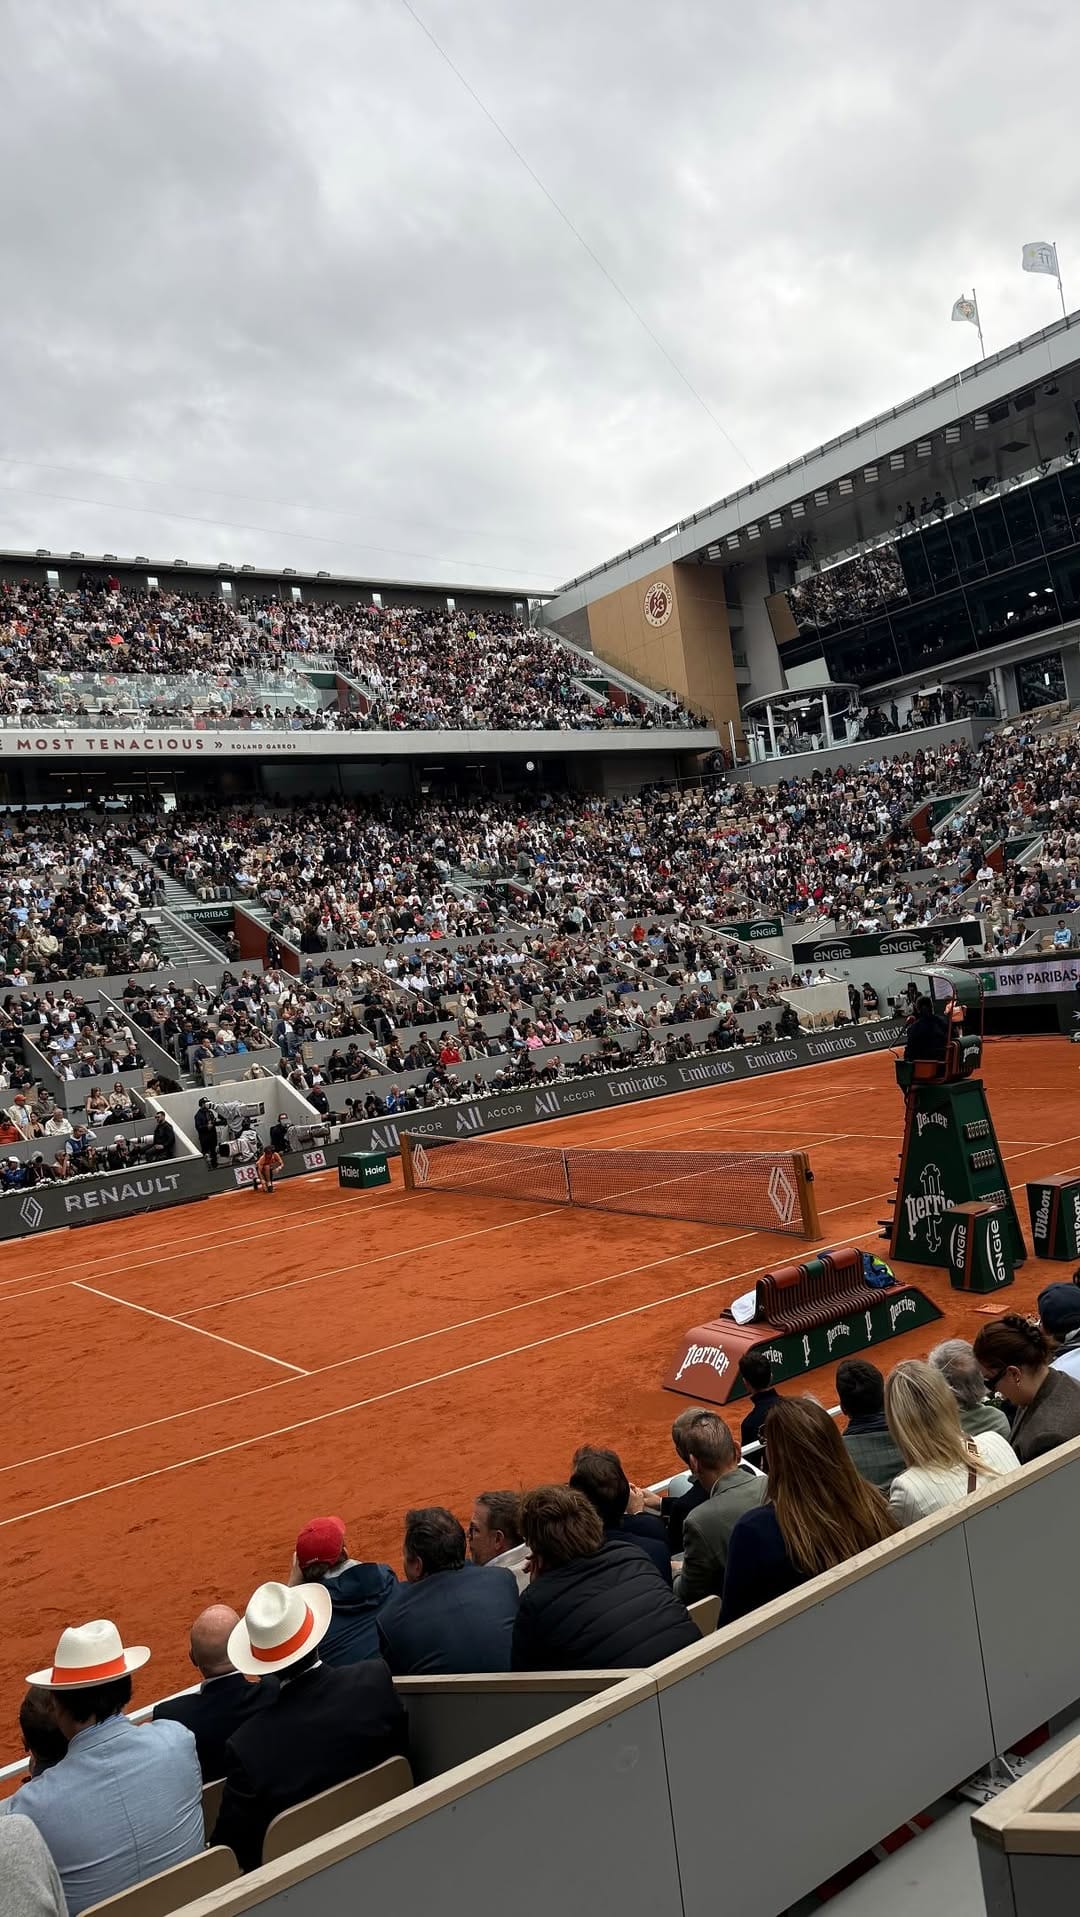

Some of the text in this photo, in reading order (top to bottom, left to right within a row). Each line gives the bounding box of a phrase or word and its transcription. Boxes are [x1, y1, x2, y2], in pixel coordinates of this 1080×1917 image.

[17, 739, 74, 750] MOST
[86, 739, 204, 750] TENACIOUS
[193, 910, 229, 920] PARIBAS
[1000, 969, 1078, 986] BNP PARIBAS
[806, 1036, 857, 1056] Emirates
[745, 1048, 798, 1069] Emirates
[678, 1060, 735, 1083] Emirates
[607, 1074, 668, 1097] Emirates
[563, 1090, 596, 1103] ACCOR
[487, 1105, 523, 1119] ACCOR
[307, 1153, 324, 1167] 18
[238, 1168, 256, 1181] 18
[341, 1165, 360, 1179] Haier
[365, 1164, 386, 1176] Haier
[64, 1173, 180, 1212] RENAULT
[905, 1190, 955, 1240] perri
[1035, 1189, 1052, 1239] Wilson
[761, 1346, 783, 1365] rier
